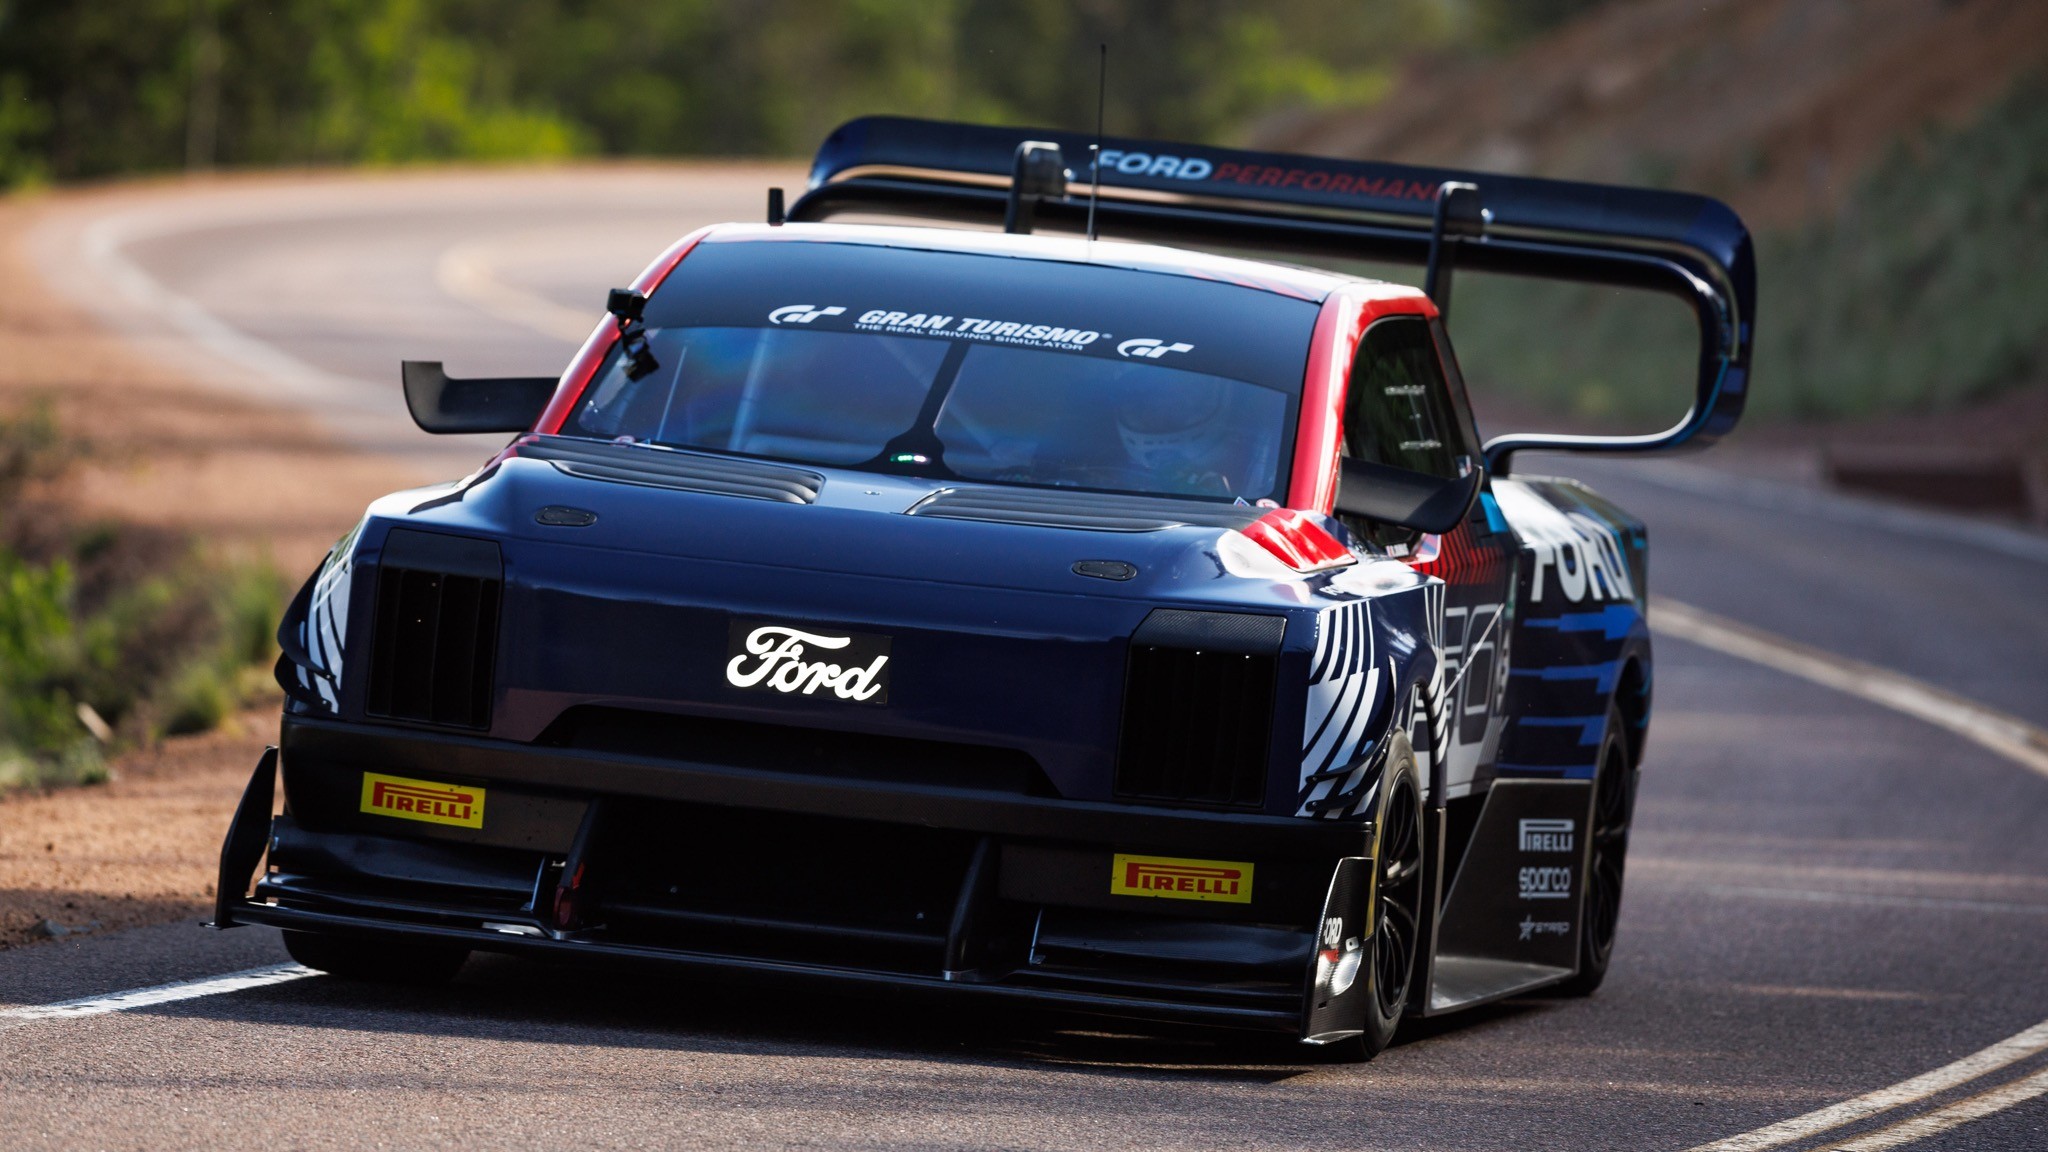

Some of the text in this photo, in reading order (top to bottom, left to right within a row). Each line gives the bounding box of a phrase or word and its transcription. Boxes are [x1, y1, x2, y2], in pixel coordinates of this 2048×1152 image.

[1090, 148, 1441, 201] FORD PERFORMAN
[854, 322, 1084, 351] THE REAL DRIVING SIMULATOR
[858, 309, 1100, 345] GRAN TURISMO
[1510, 487, 1634, 602] FORD
[726, 626, 889, 701] Ford
[372, 781, 474, 819] PIRELLI
[1519, 818, 1574, 851] PIRELLI
[1125, 862, 1242, 895] PIRELLI
[1518, 866, 1572, 898] sparco
